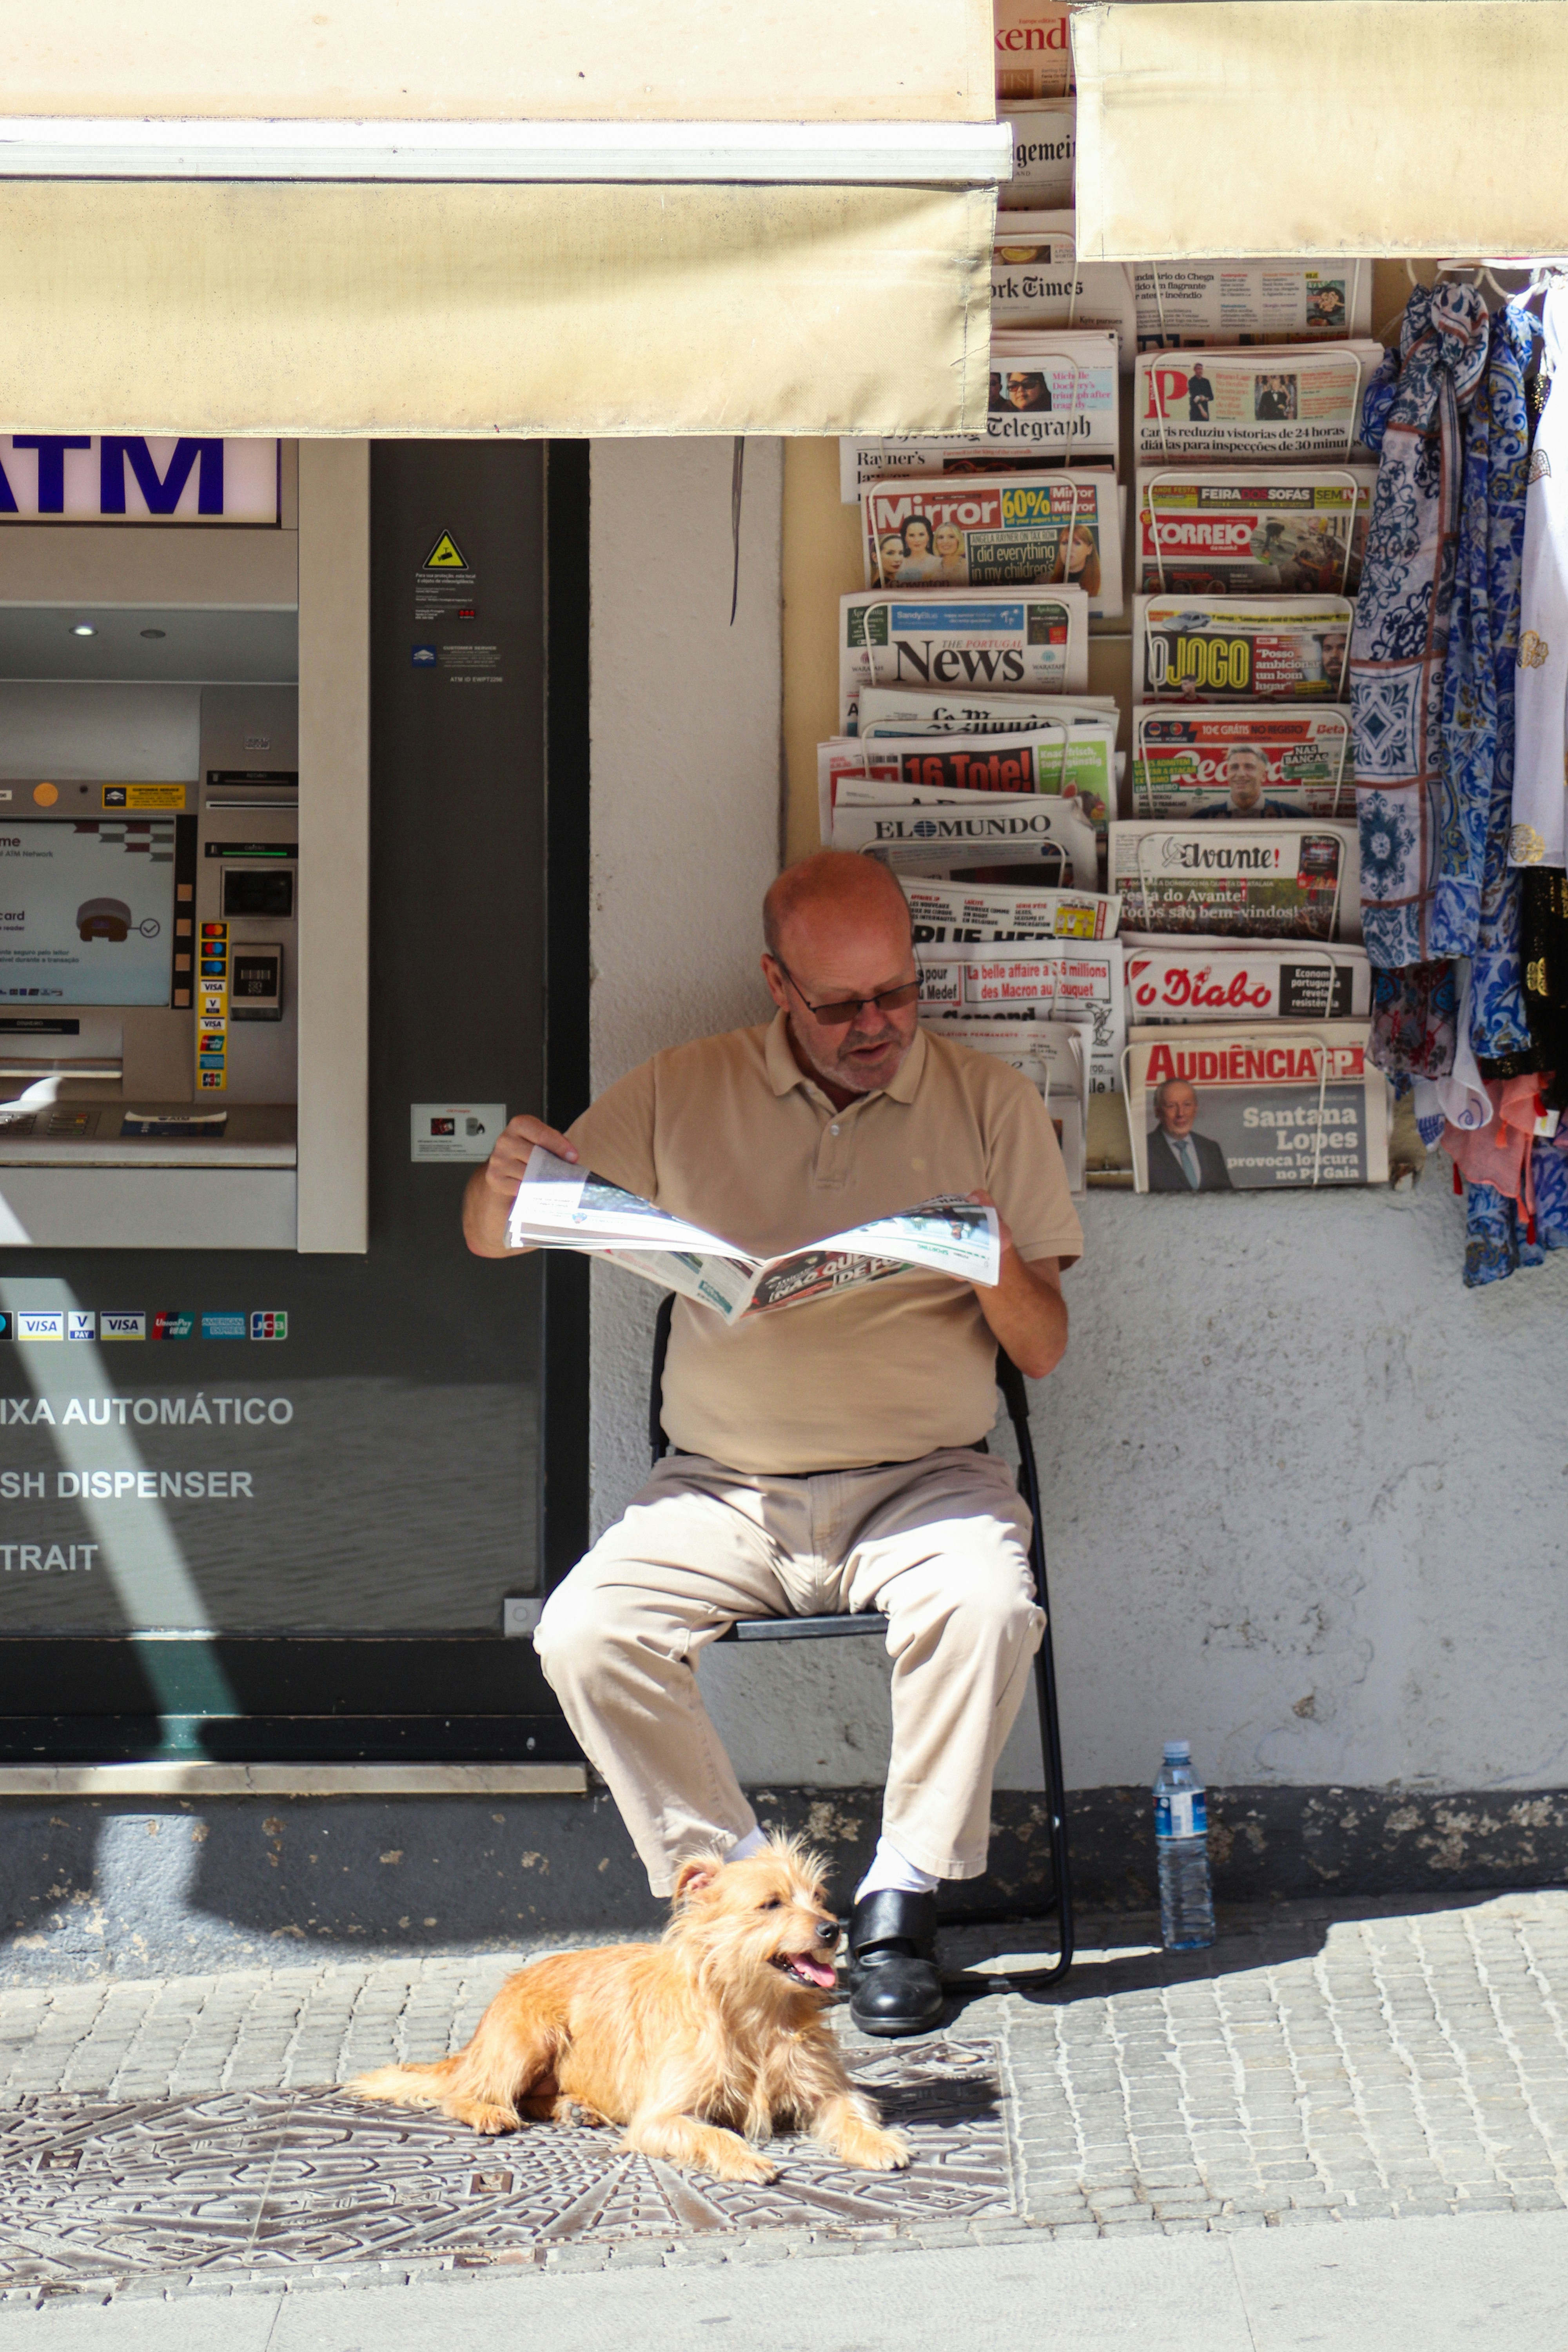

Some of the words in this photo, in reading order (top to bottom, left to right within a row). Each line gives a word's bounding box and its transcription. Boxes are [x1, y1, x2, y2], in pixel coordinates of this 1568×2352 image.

[1187, 273, 1214, 281] Chega
[1022, 276, 1083, 298] Times
[1168, 282, 1206, 290] flagrante
[1090, 390, 1111, 398] after
[987, 415, 1091, 441] Telegraph
[1179, 427, 1225, 437] reduziu
[1227, 428, 1276, 439] vistorias
[1279, 428, 1293, 438] de
[1296, 428, 1308, 437] 24
[1313, 426, 1345, 436] horas
[1183, 443, 1210, 452] para
[1213, 439, 1276, 453] inspecções
[1279, 441, 1293, 451] de
[1296, 440, 1311, 450] 30
[0, 435, 223, 515] TM
[1201, 489, 1241, 500] FEIRA
[1241, 488, 1267, 500] DOS
[1267, 488, 1310, 500] SOFÁS
[1316, 490, 1341, 499] SEM
[1342, 489, 1367, 499] IVA
[1002, 490, 1051, 518] 60%
[876, 495, 998, 529] Mirror
[996, 532, 1018, 542] RAYNER
[1030, 531, 1041, 540] TAX
[1148, 522, 1252, 545] CORREIO
[977, 545, 994, 562] did
[996, 543, 1055, 563] everything
[972, 565, 981, 580] in
[984, 566, 1002, 582] my
[1004, 561, 1054, 579] children's
[897, 611, 938, 620] SandyBlue
[966, 640, 1023, 648] PORTUGAL
[891, 640, 1025, 682] News
[1166, 637, 1250, 689] JOGO
[1256, 660, 1322, 669] ambicionar
[1256, 672, 1275, 680] um
[1277, 671, 1303, 680] bom
[1221, 723, 1249, 735] GRÁTIS
[1251, 726, 1266, 734] NO
[1268, 725, 1303, 734] REGISTO
[1295, 746, 1317, 754] NAS
[1284, 752, 1328, 764] BANCAS
[905, 757, 942, 786] 16
[950, 750, 1033, 792] Tote!
[875, 821, 914, 839] EL
[936, 815, 1051, 837] MUNDO
[1180, 843, 1279, 869] Avante!
[1163, 888, 1183, 902] do
[1187, 887, 1246, 902] Avante!
[1200, 905, 1299, 918] bem-vindos!
[926, 968, 947, 980] pour
[967, 965, 978, 980] La
[982, 965, 1005, 980] belle
[1009, 963, 1040, 979] affaire
[1069, 963, 1107, 978] millions
[927, 985, 958, 1000] Medef
[981, 984, 998, 1000] des
[1001, 982, 1037, 998] Macron
[1041, 983, 1053, 996] au
[1058, 982, 1094, 998] ouquet
[1161, 966, 1272, 1008] Diabo
[1145, 1044, 1317, 1081] AUDIÊNCIA
[1243, 1106, 1358, 1128] Santana
[1276, 1130, 1358, 1154] Lopes
[1227, 1156, 1293, 1170] provoca
[1276, 1170, 1297, 1180] no
[1323, 1165, 1359, 1179] Gaia
[25, 1320, 57, 1332] VISA
[78, 1315, 88, 1328] V
[109, 1319, 139, 1331] VISA
[156, 1319, 191, 1328] UnionPay
[254, 1320, 287, 1331] JCB
[0, 1398, 55, 1425] IXA
[62, 1392, 294, 1425] AUTOMÁTICO
[0, 1472, 45, 1498] SH
[57, 1471, 254, 1499] DISPENSER
[0, 1544, 98, 1570] TRAIT
